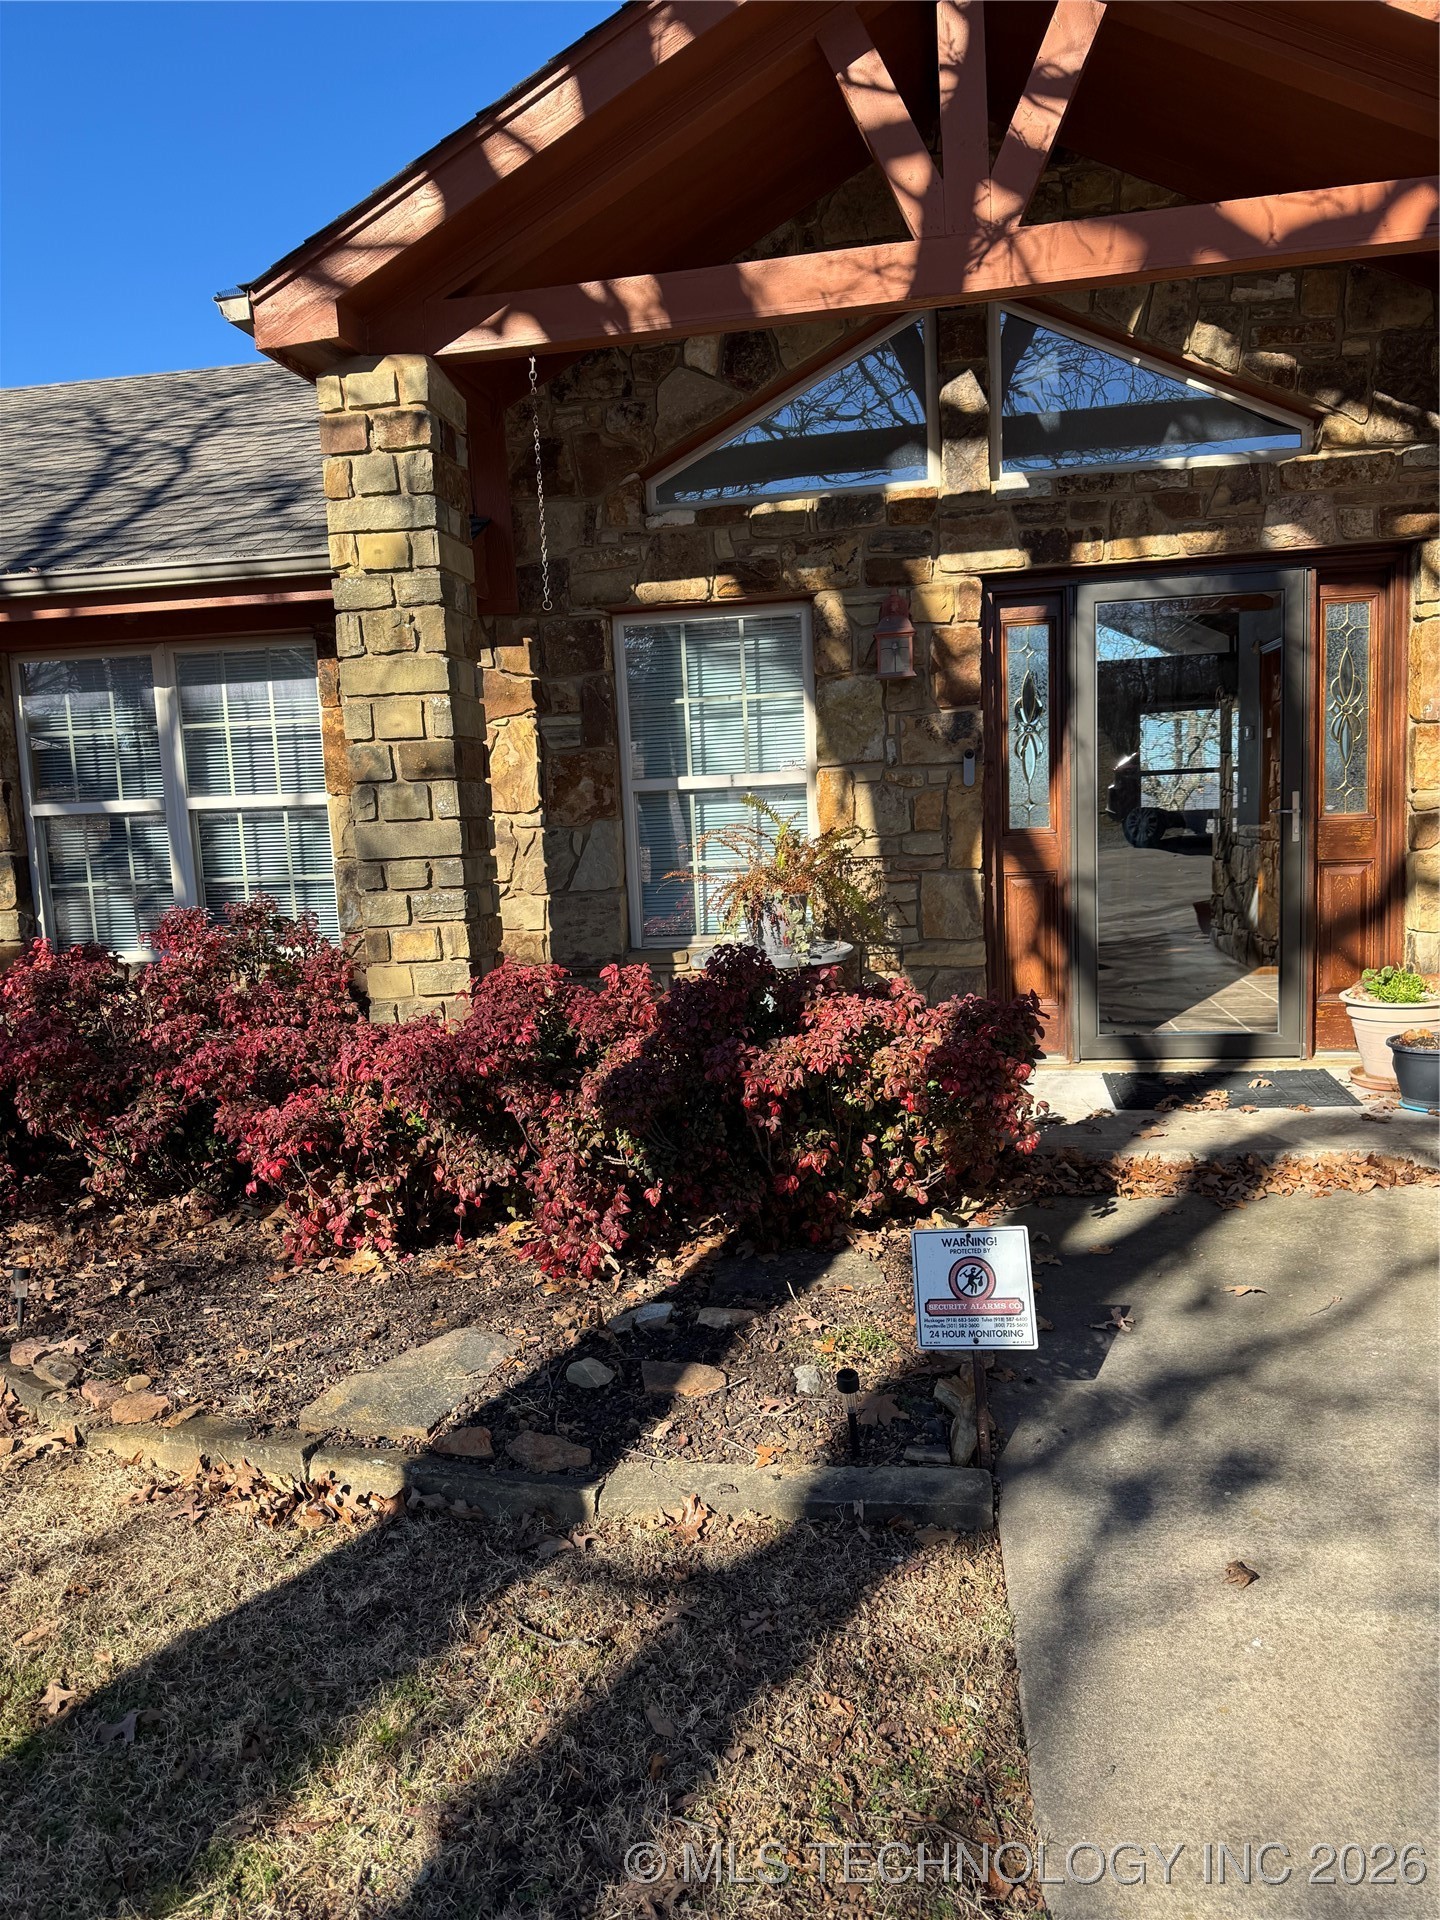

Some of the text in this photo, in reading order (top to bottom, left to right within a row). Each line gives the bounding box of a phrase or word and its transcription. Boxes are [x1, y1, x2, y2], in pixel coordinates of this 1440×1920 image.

[941, 1237, 997, 1247] WARNING!
[942, 1330, 966, 1338] HOUR
[968, 1330, 1024, 1338] MONITORING
